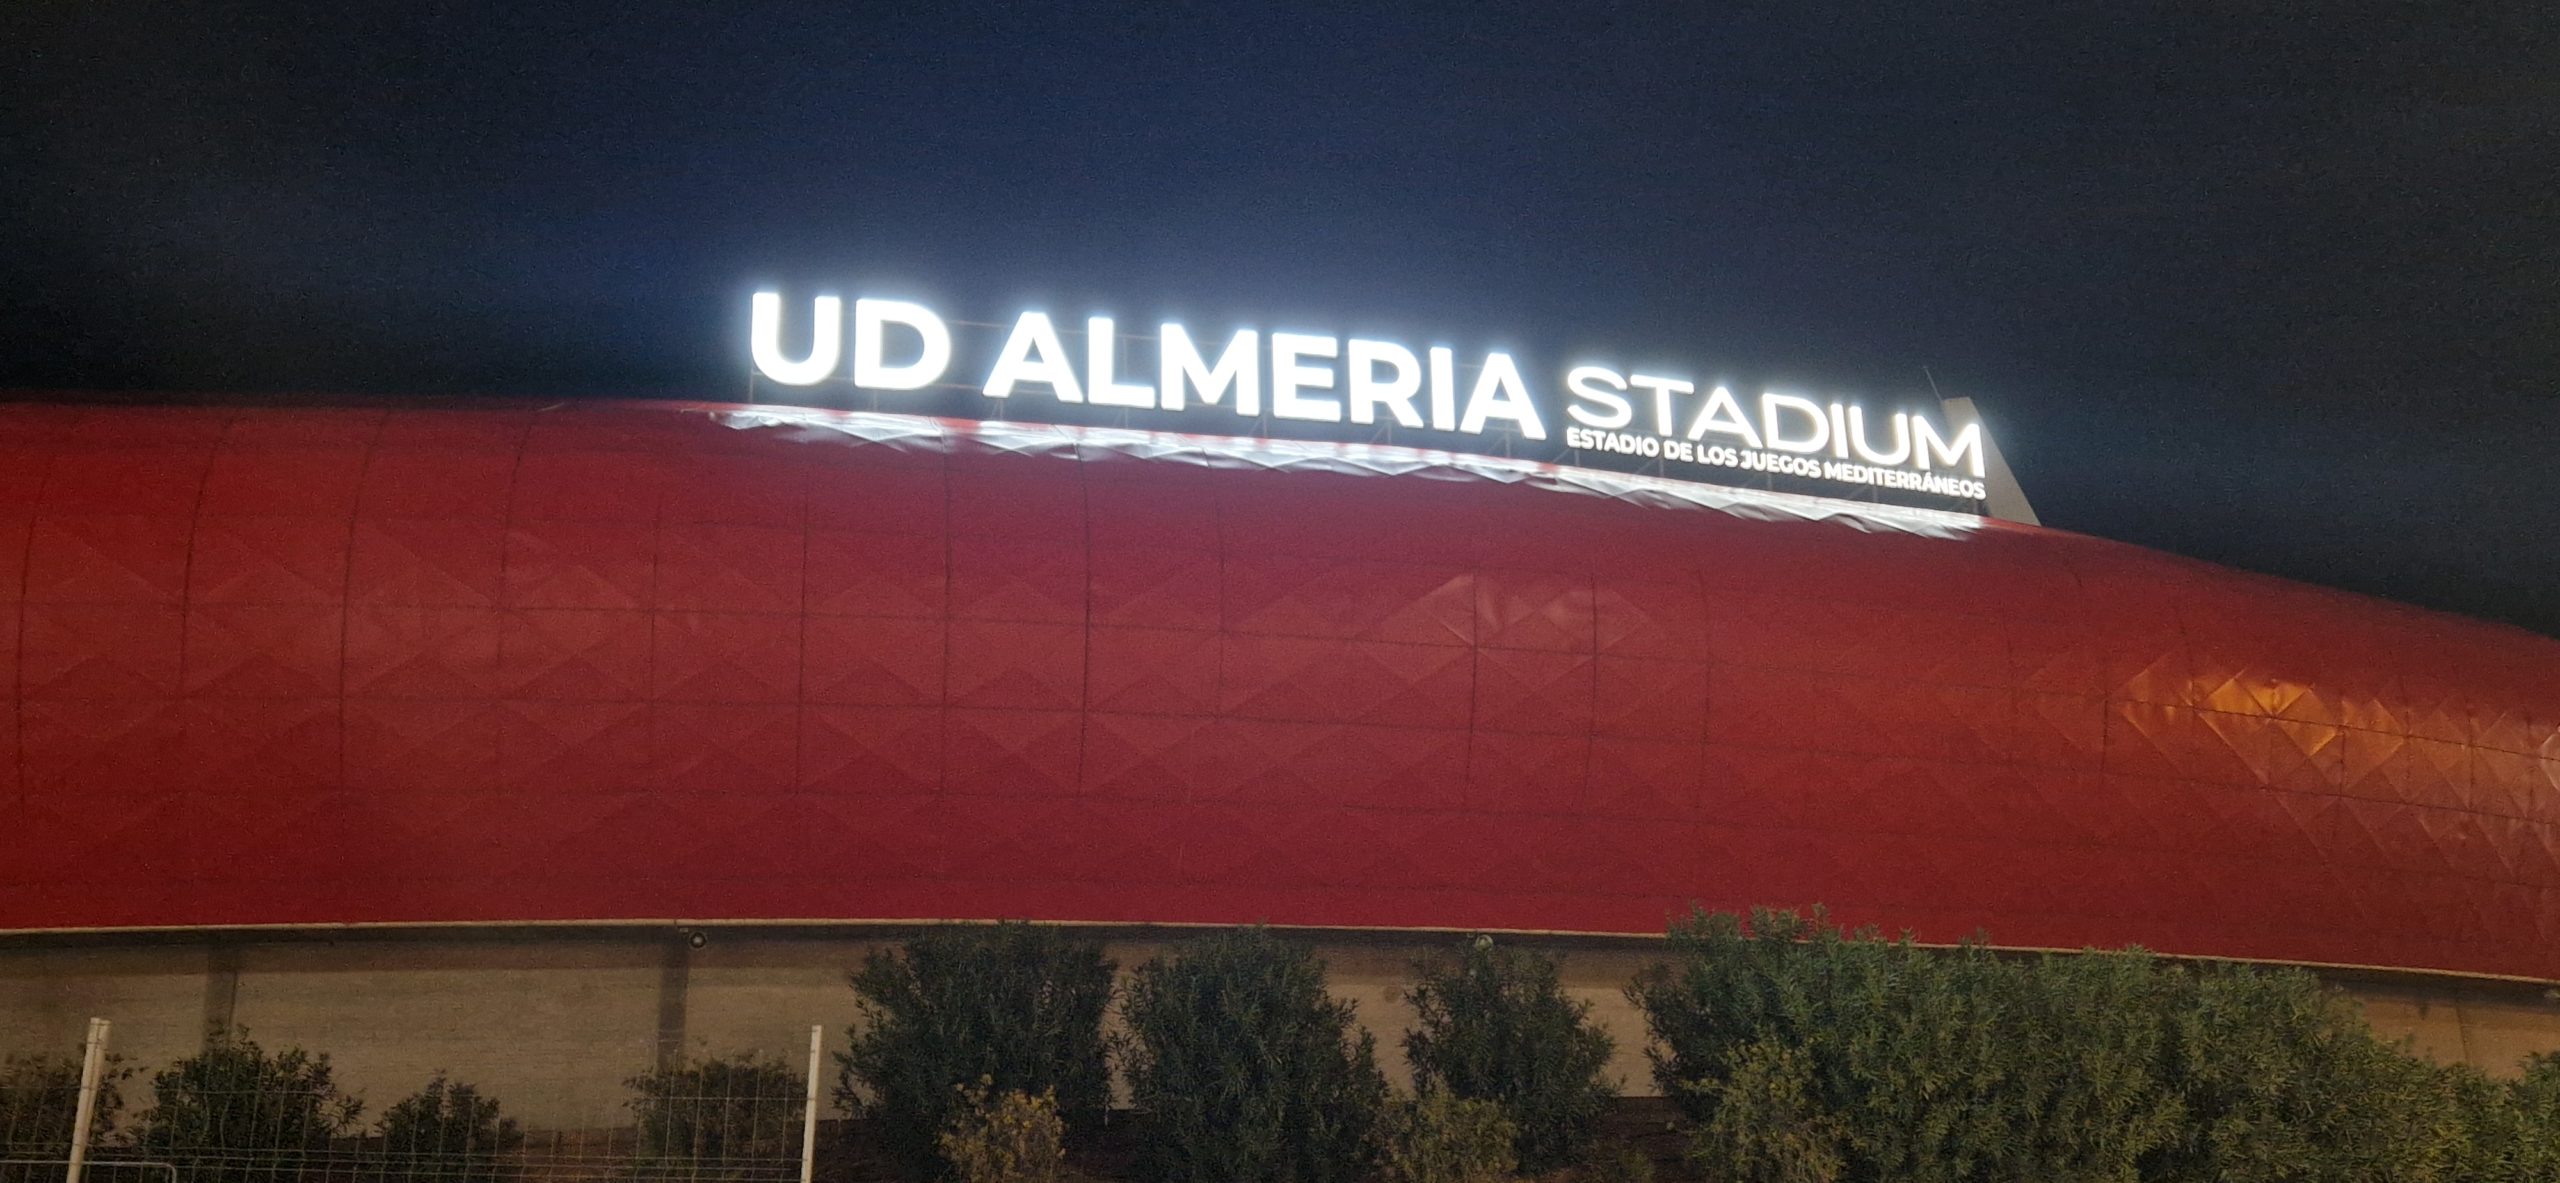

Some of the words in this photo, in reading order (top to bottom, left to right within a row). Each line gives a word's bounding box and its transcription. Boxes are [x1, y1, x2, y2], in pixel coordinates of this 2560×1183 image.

[750, 291, 951, 390] UD
[981, 311, 1547, 440] ALMERIA
[1566, 365, 1986, 479] STADIUM
[1566, 426, 1660, 457] ESTADIO
[1663, 439, 1694, 462] DE
[1697, 444, 1739, 467] LOS
[1740, 449, 1822, 479] JUEGOS
[1823, 461, 1987, 500] MEDITERRÁNEOS
